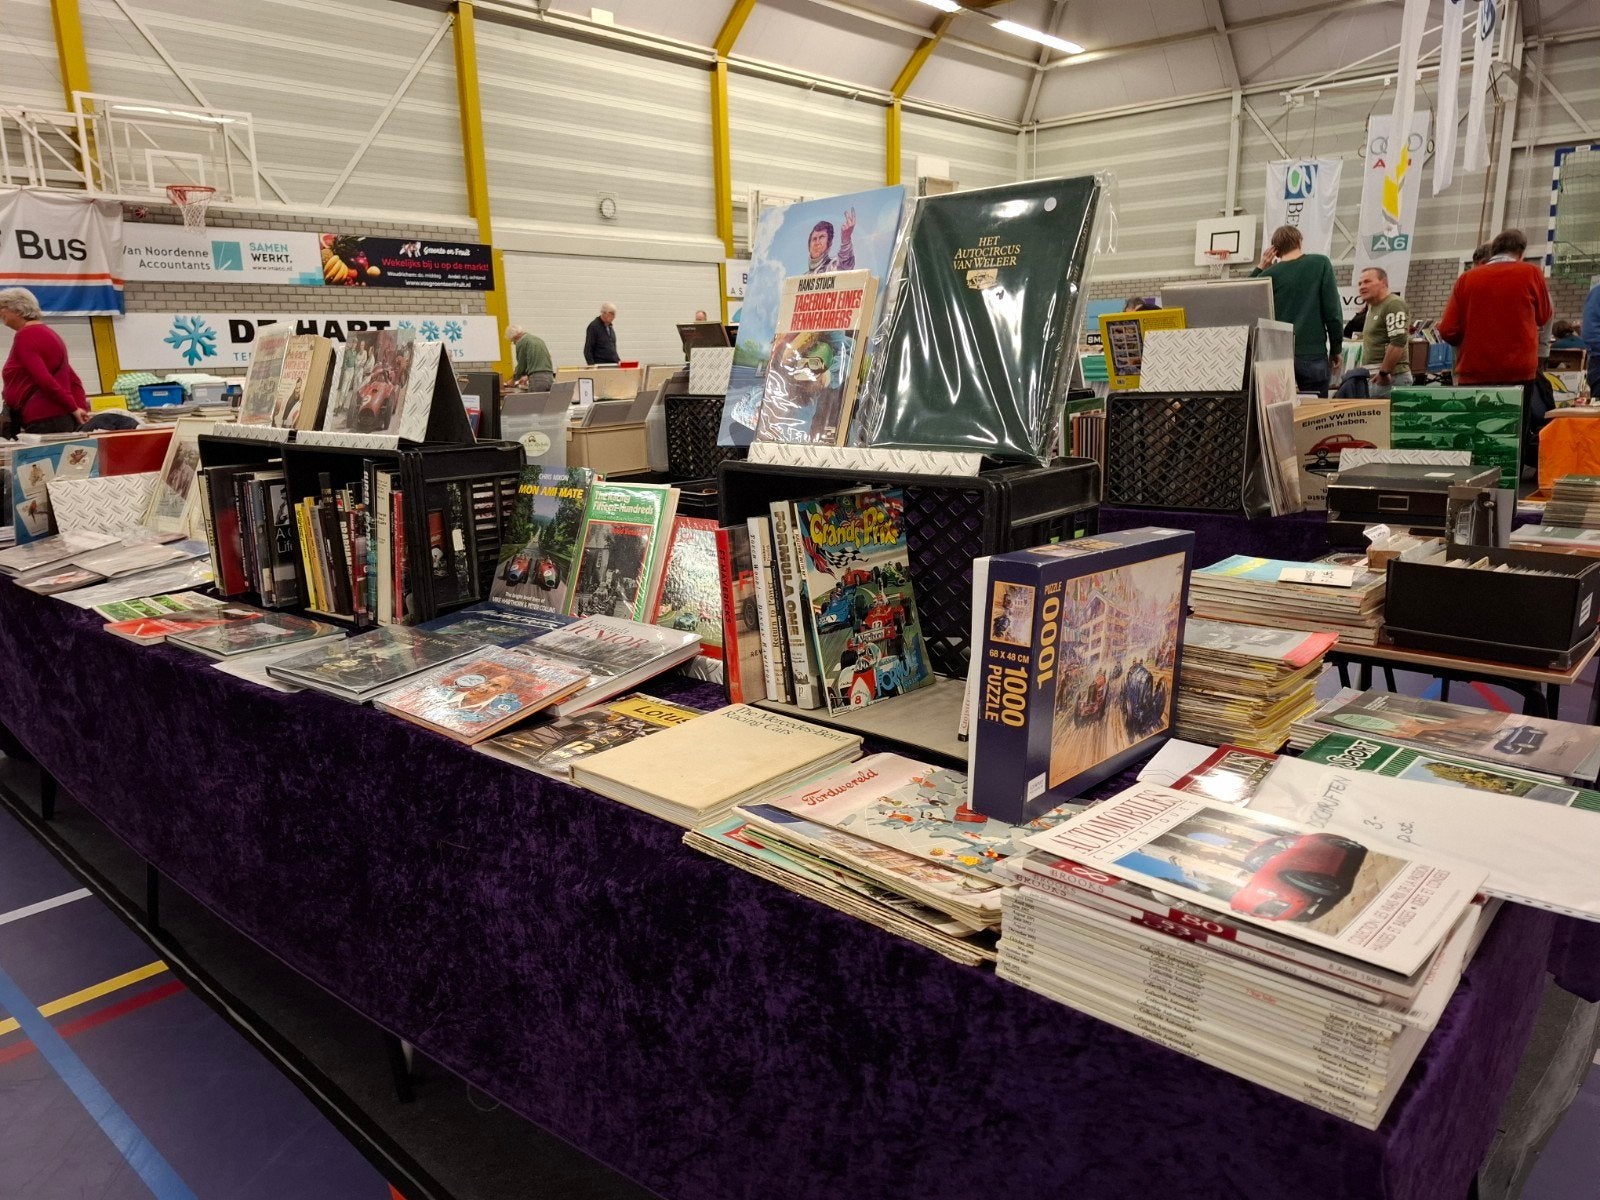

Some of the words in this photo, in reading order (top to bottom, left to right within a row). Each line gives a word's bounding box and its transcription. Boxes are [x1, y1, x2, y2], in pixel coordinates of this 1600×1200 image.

[15, 230, 87, 261] Bus
[145, 246, 208, 258] Noordenne
[249, 242, 288, 252] SAMEN
[954, 244, 1021, 259] AUTOCIRCUS
[978, 236, 1000, 246] HET
[1374, 237, 1407, 250] A6
[139, 259, 211, 270] Accountants
[251, 253, 293, 263] WERKT.
[381, 258, 421, 269] Wekelijks
[423, 260, 432, 270] bij
[953, 259, 973, 270] VAN
[974, 256, 1016, 268] WELEER
[798, 278, 815, 292] HANS
[816, 276, 836, 290] STUCK
[794, 291, 838, 312] TAGEBUCH
[837, 289, 864, 310] EINES
[790, 310, 852, 332] RENNFAHRERS
[1302, 417, 1327, 428] Einen
[1329, 412, 1345, 422] VW
[1348, 409, 1382, 418] müsste
[1315, 422, 1335, 431] man
[1337, 418, 1368, 427] haben.
[518, 484, 540, 495] MON
[540, 486, 558, 496] AMI
[559, 488, 584, 499] MATE
[810, 513, 861, 549] Grands
[862, 506, 898, 546] Prix
[774, 511, 794, 598] FORMULA
[786, 599, 800, 636] ONE
[720, 564, 732, 623] MAVERICKS
[563, 624, 649, 648] JUNIOR
[1036, 596, 1060, 690] 1000
[1000, 650, 1006, 660] X
[1006, 652, 1016, 661] 48
[1017, 654, 1030, 664] CM
[854, 695, 862, 704] 8
[984, 664, 1003, 722] PUZZLE
[1000, 666, 1028, 727] 1000
[722, 710, 760, 726] Racing
[764, 722, 793, 736] Cars
[736, 706, 758, 716] The
[757, 712, 850, 742] Mercedes-Benz
[801, 768, 879, 806] Fordwereld
[1049, 790, 1183, 855] AUTOMOBILES
[1015, 874, 1067, 897] BROOKS
[1050, 870, 1104, 894] BROOKS
